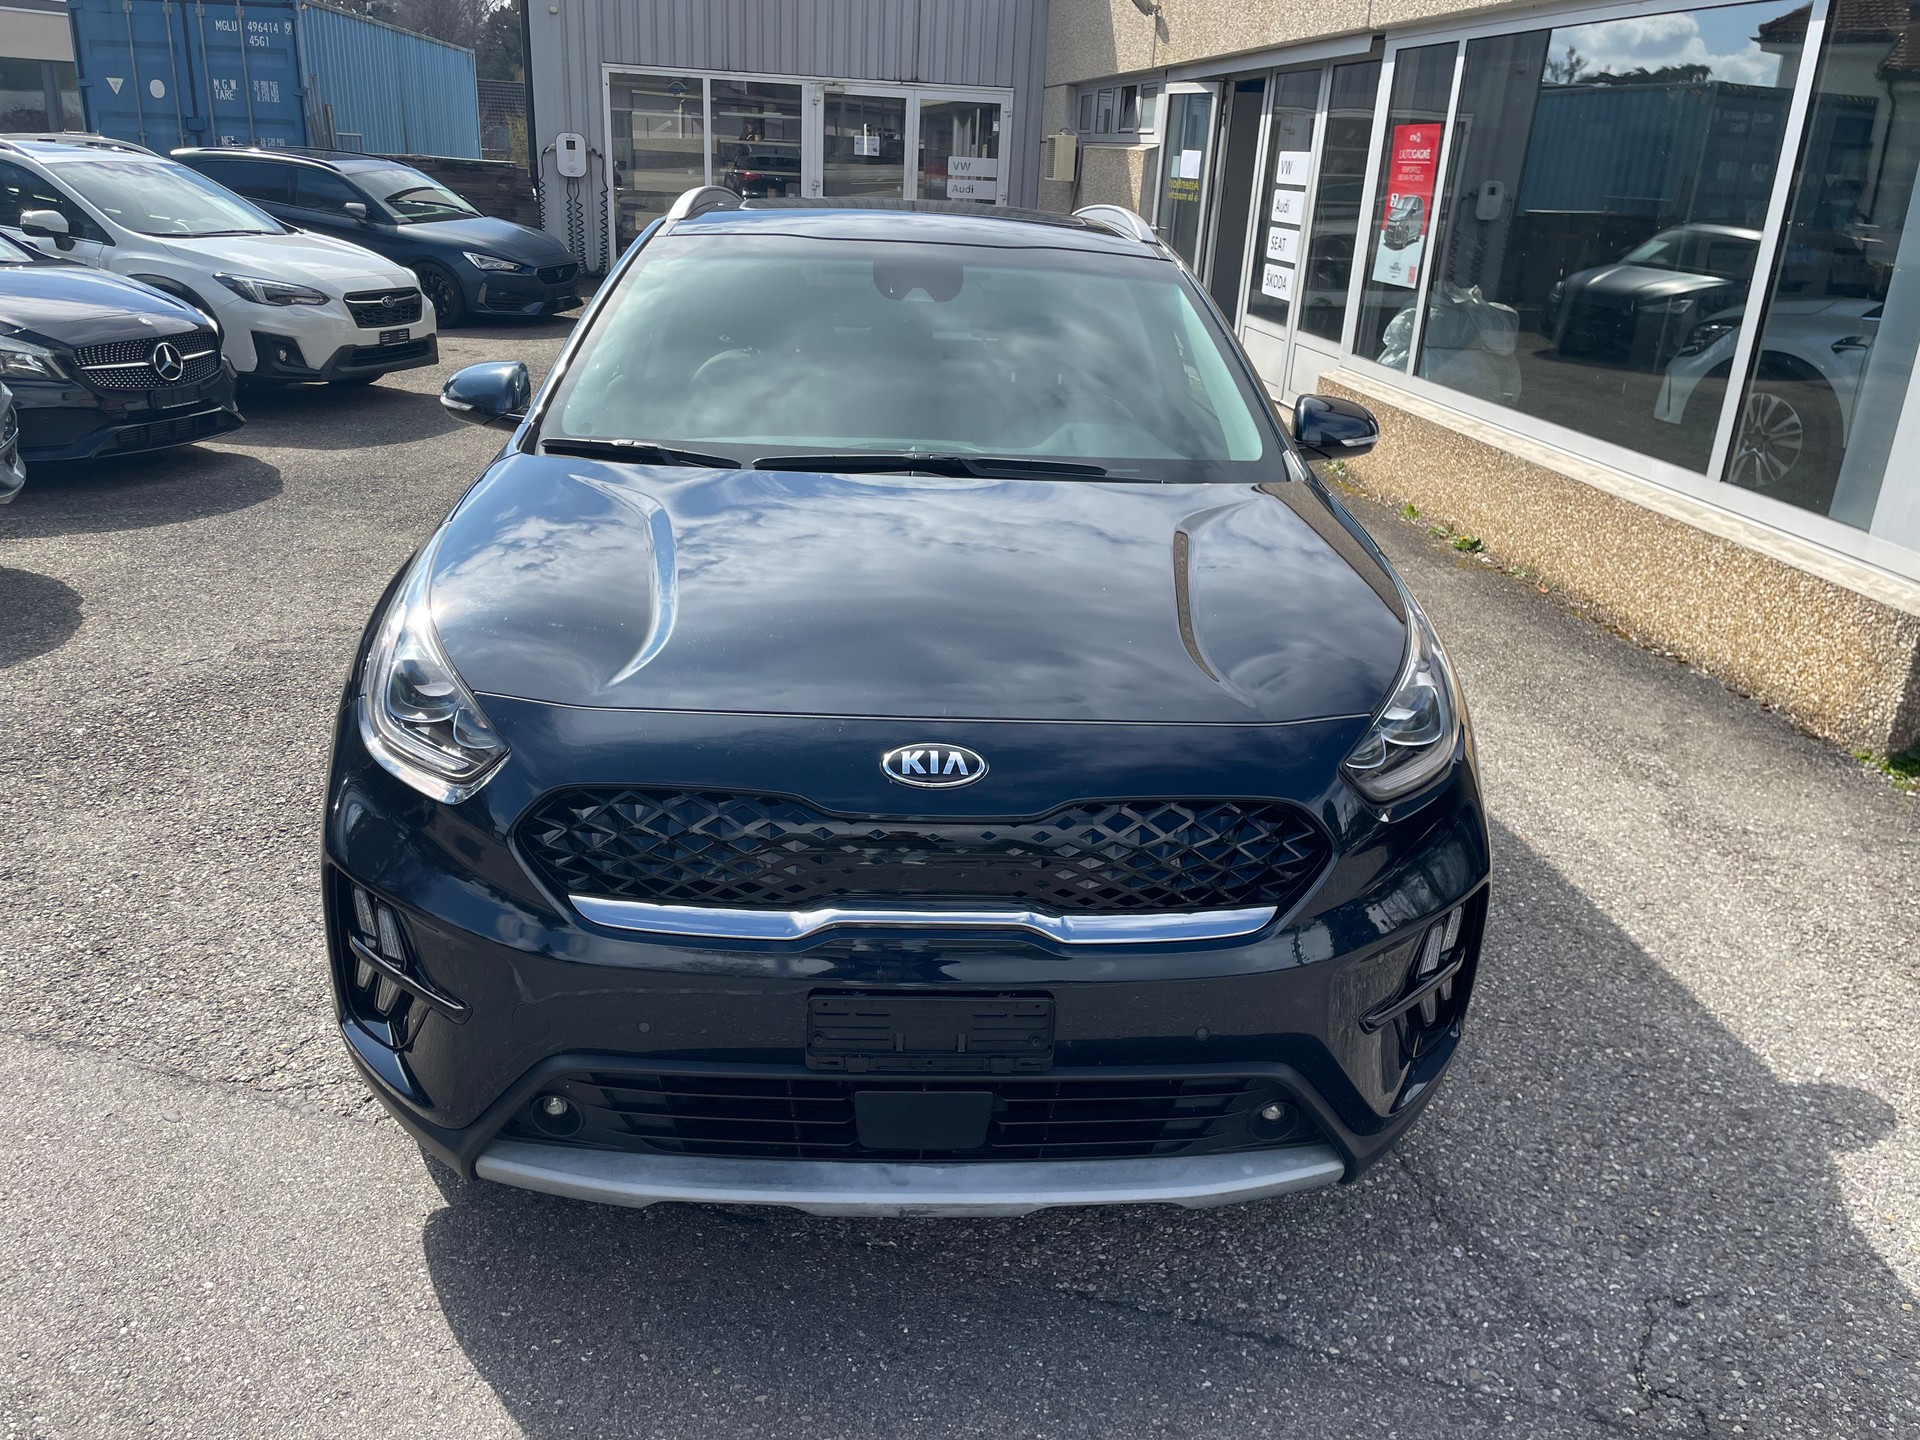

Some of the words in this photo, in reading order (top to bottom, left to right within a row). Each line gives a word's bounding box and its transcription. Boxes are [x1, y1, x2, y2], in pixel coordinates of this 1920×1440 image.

[215, 20, 238, 32] MGLU
[247, 21, 279, 34] 496414
[249, 35, 270, 47] 45G1
[213, 78, 239, 91] M.G.W.
[214, 89, 235, 101] TARE
[953, 161, 971, 171] VW
[1281, 160, 1294, 175] VW
[951, 184, 974, 194] Audi
[1275, 199, 1291, 214] Audi
[1270, 235, 1287, 252] SEAT
[1265, 268, 1287, 291] ŠKODA
[900, 750, 969, 776] KIA
